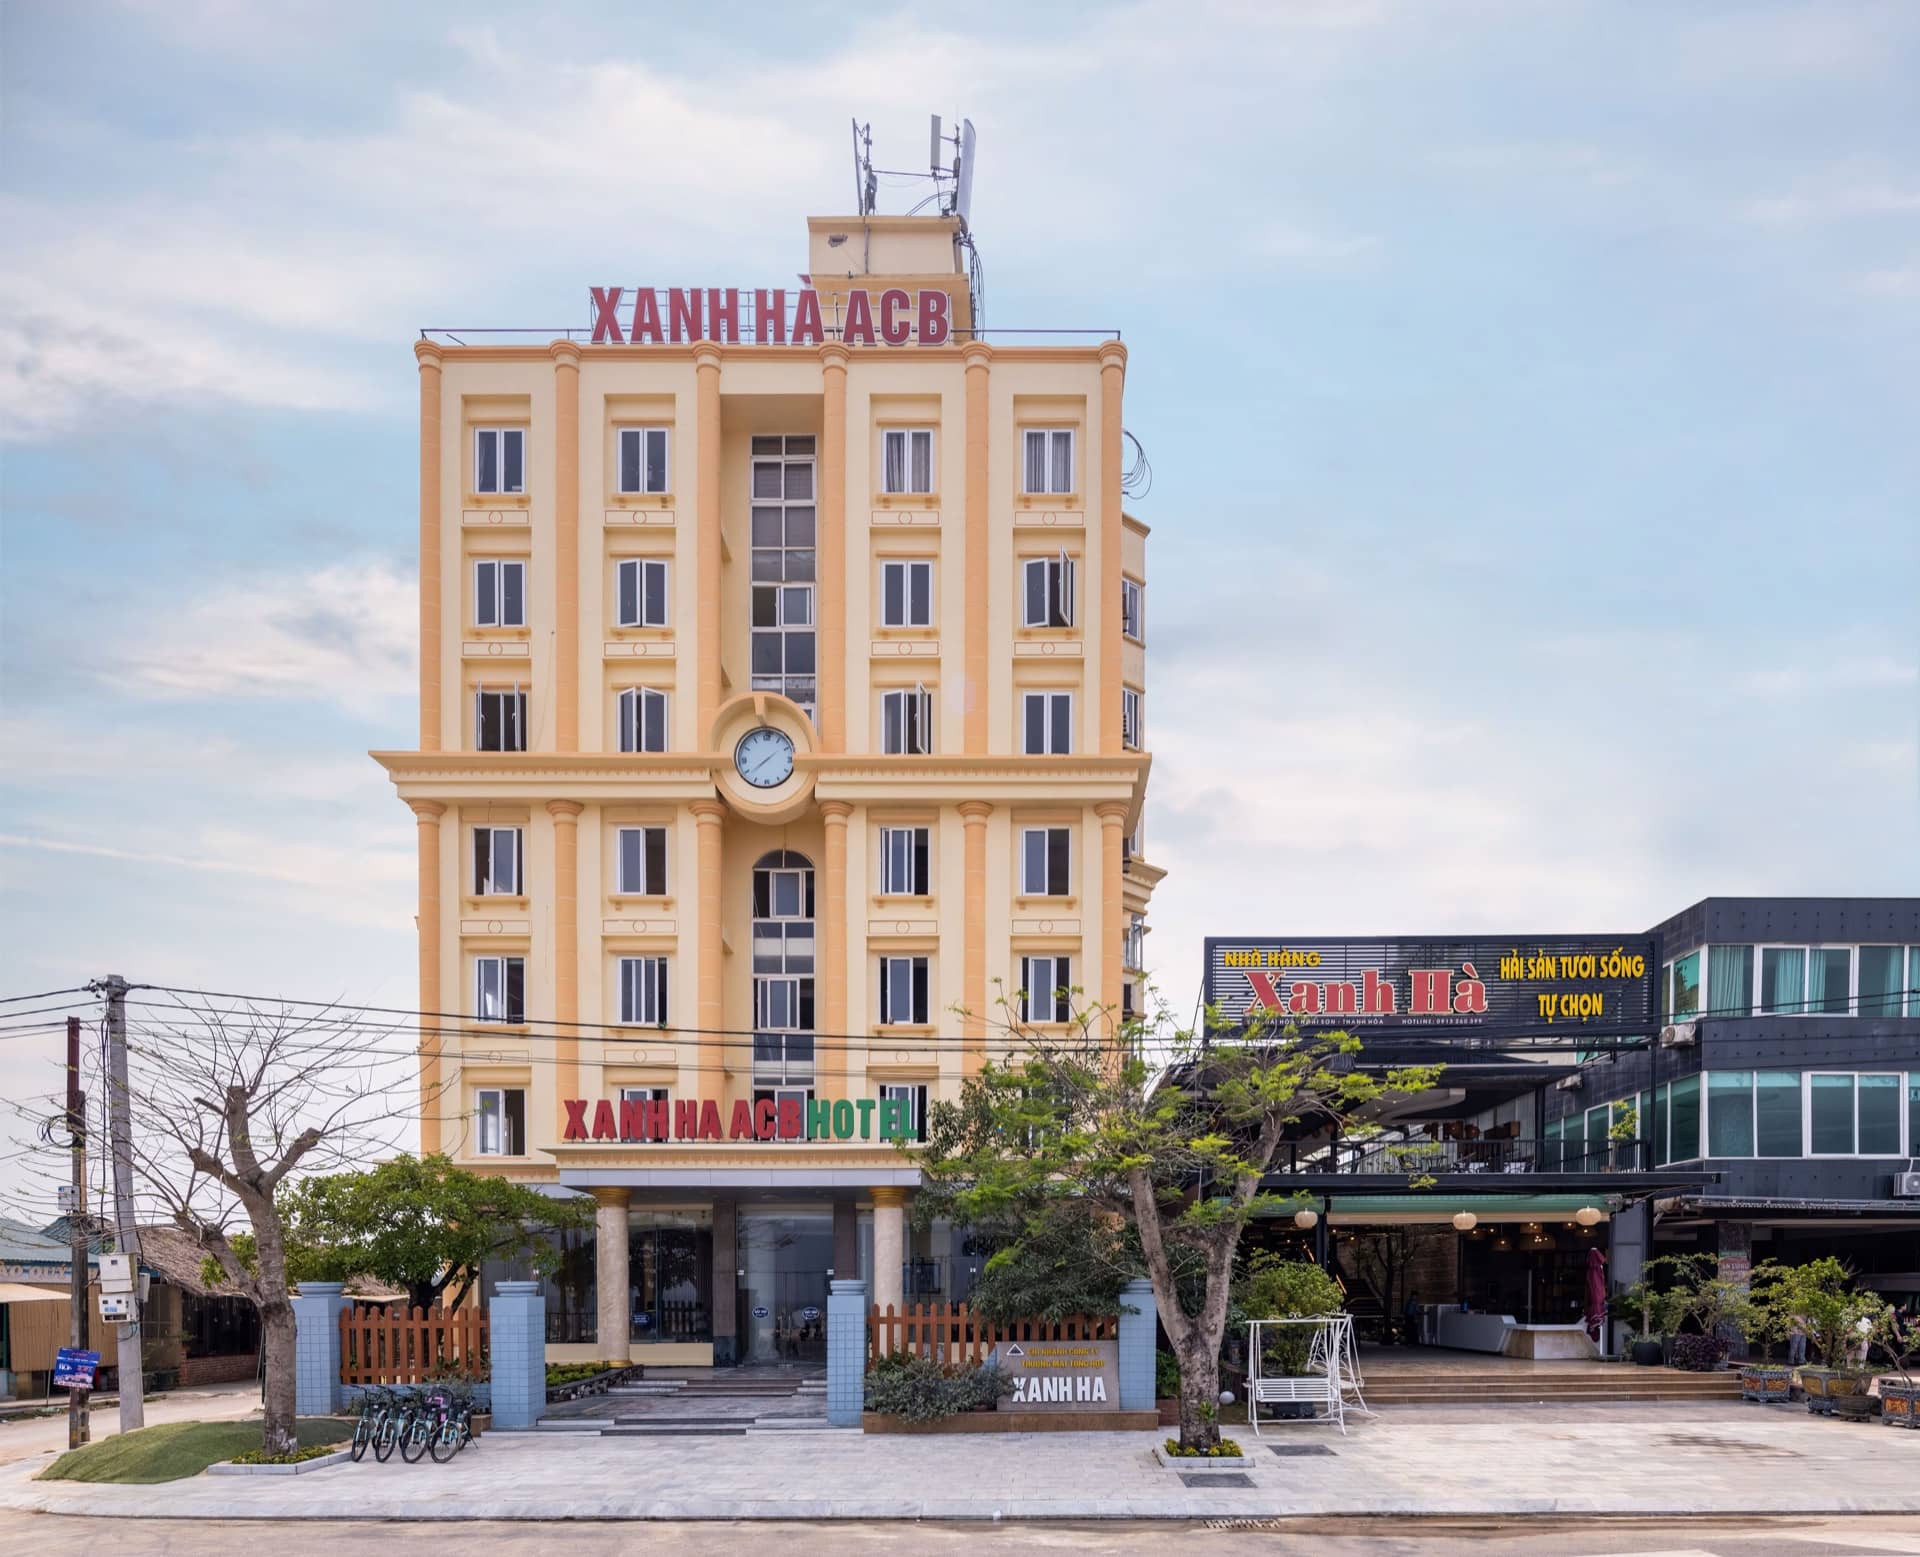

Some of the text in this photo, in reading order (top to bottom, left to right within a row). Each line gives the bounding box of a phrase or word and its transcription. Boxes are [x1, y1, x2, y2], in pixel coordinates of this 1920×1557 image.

[589, 274, 951, 346] XANH HÀ ACB
[1224, 947, 1322, 967] NHÀ HÀNG
[1499, 945, 1646, 980] HẢI SẢN TƯƠI SỐNG
[1242, 961, 1489, 1016] Xanh Hà
[1537, 992, 1604, 1024] TỰ CHỌN
[564, 1098, 918, 1140] XANH HA ACB HOTEL
[1012, 1375, 1107, 1403] XANH HA
